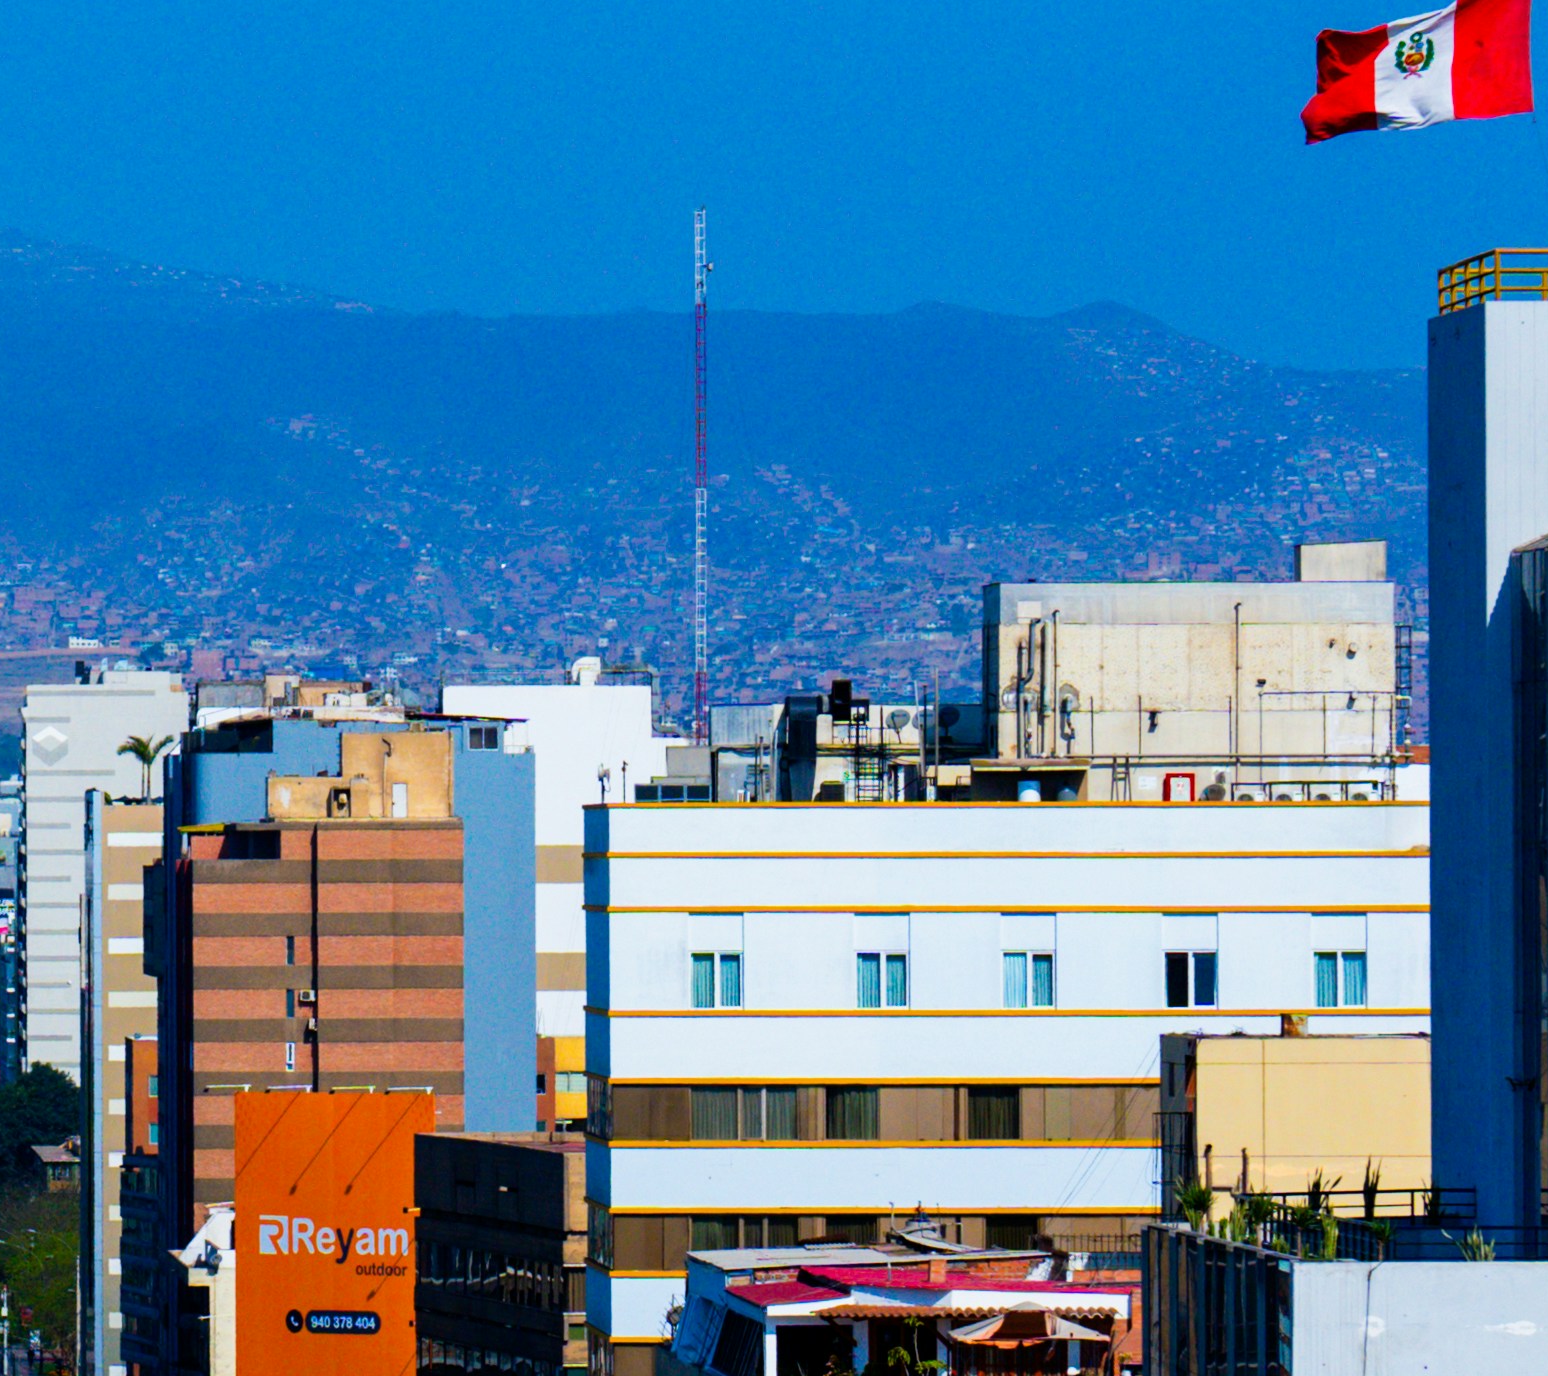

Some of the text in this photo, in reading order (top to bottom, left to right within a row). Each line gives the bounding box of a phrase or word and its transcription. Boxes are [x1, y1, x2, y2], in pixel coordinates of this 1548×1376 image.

[292, 1217, 408, 1264] Reyam
[355, 1262, 407, 1276] outdoor
[311, 1316, 376, 1330] 940 378 404
